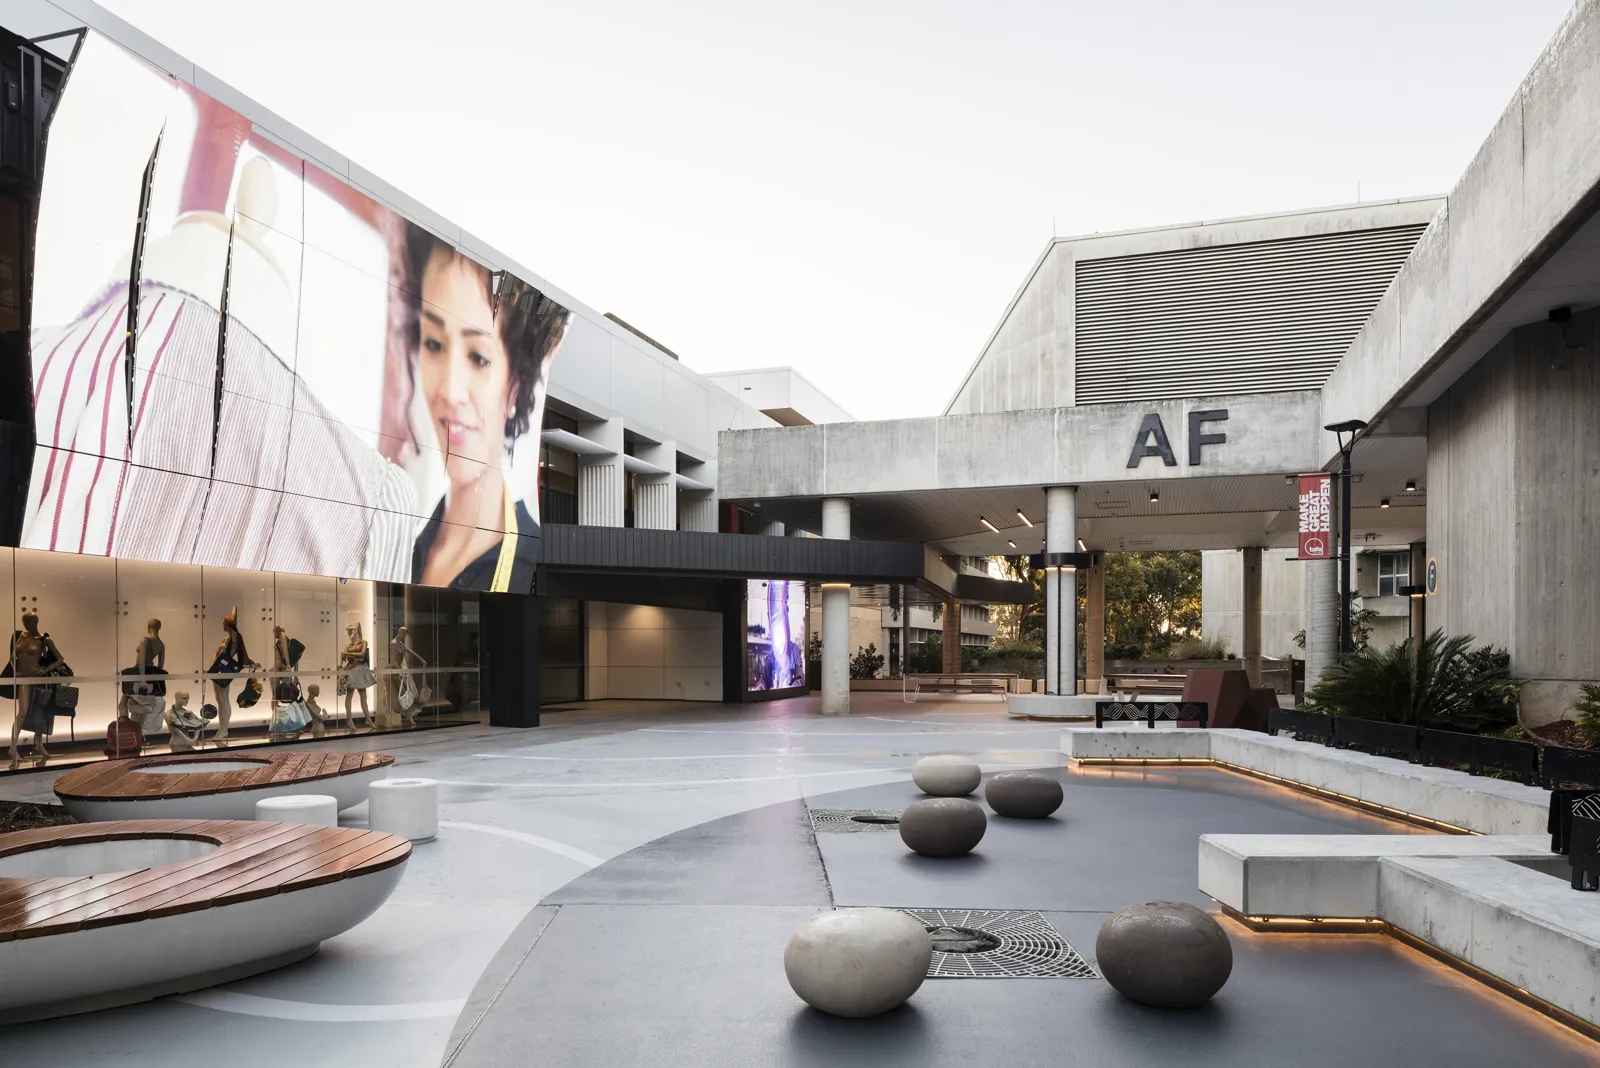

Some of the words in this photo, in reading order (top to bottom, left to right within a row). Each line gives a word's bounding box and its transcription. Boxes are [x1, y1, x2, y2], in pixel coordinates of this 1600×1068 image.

[1299, 494, 1309, 532] MAKE
[1309, 490, 1320, 532] GREAT
[1320, 479, 1330, 532] HAPPEN
